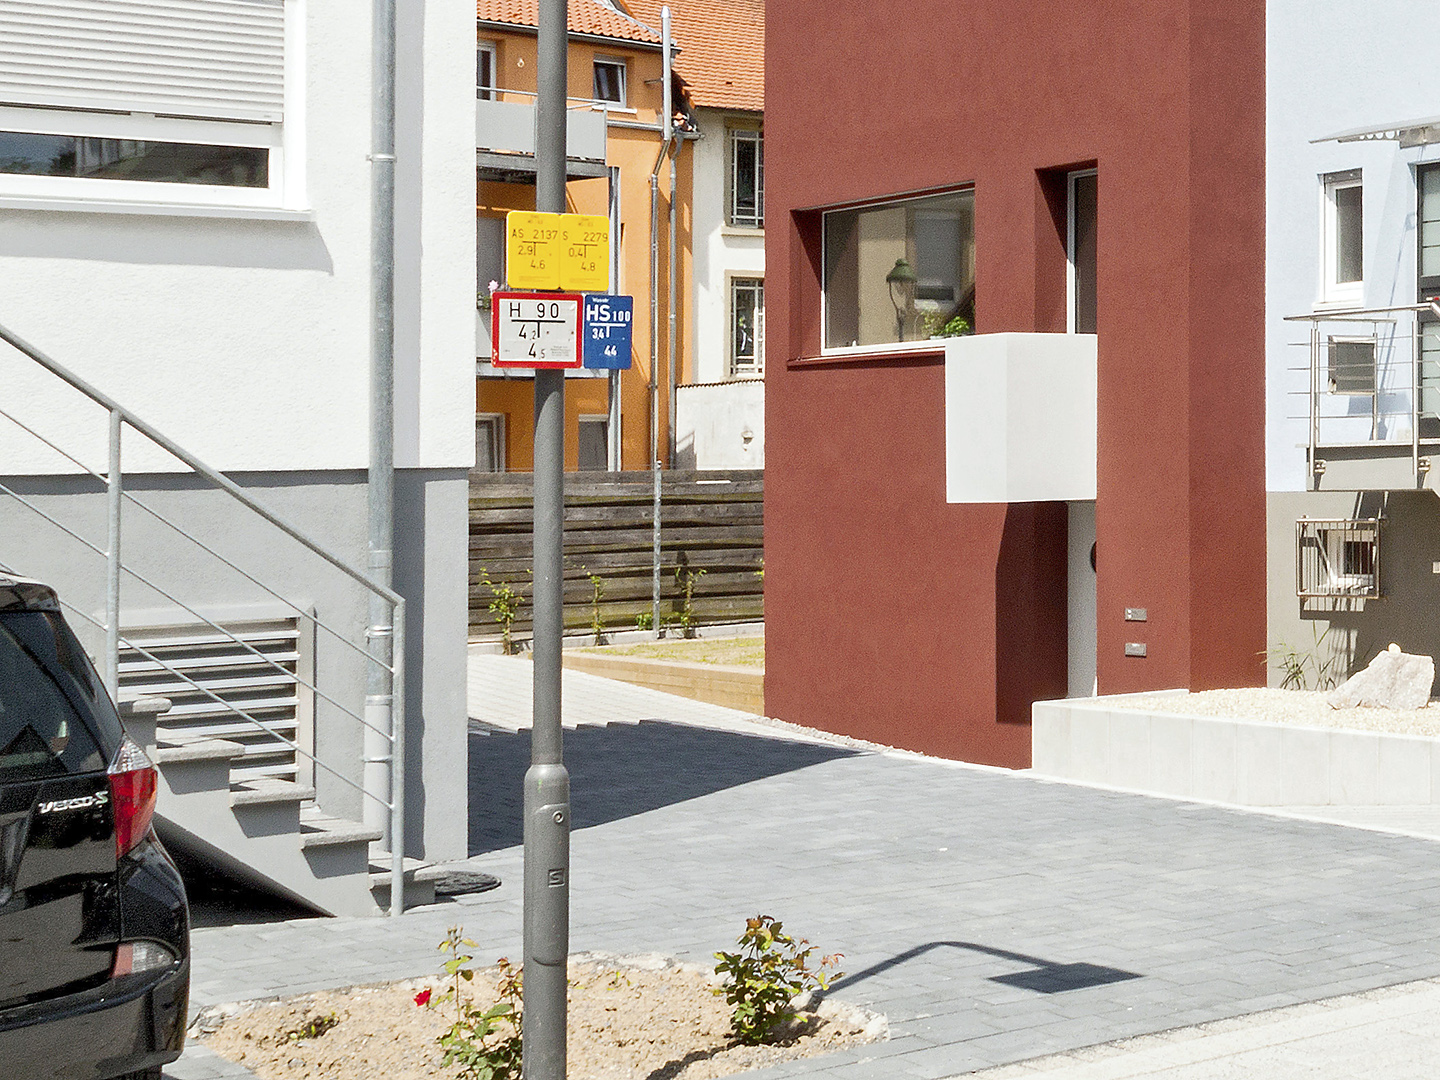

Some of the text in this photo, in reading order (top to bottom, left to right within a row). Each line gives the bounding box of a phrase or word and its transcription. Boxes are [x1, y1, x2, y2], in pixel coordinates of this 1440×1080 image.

[512, 228, 558, 240] AS 2137
[583, 232, 608, 242] 2279
[518, 245, 533, 255] 2.9
[568, 248, 583, 257] 0.4
[530, 260, 545, 270] 4.6
[581, 262, 596, 271] 4.8
[509, 302, 559, 318] H 90
[586, 304, 630, 321] HS 100
